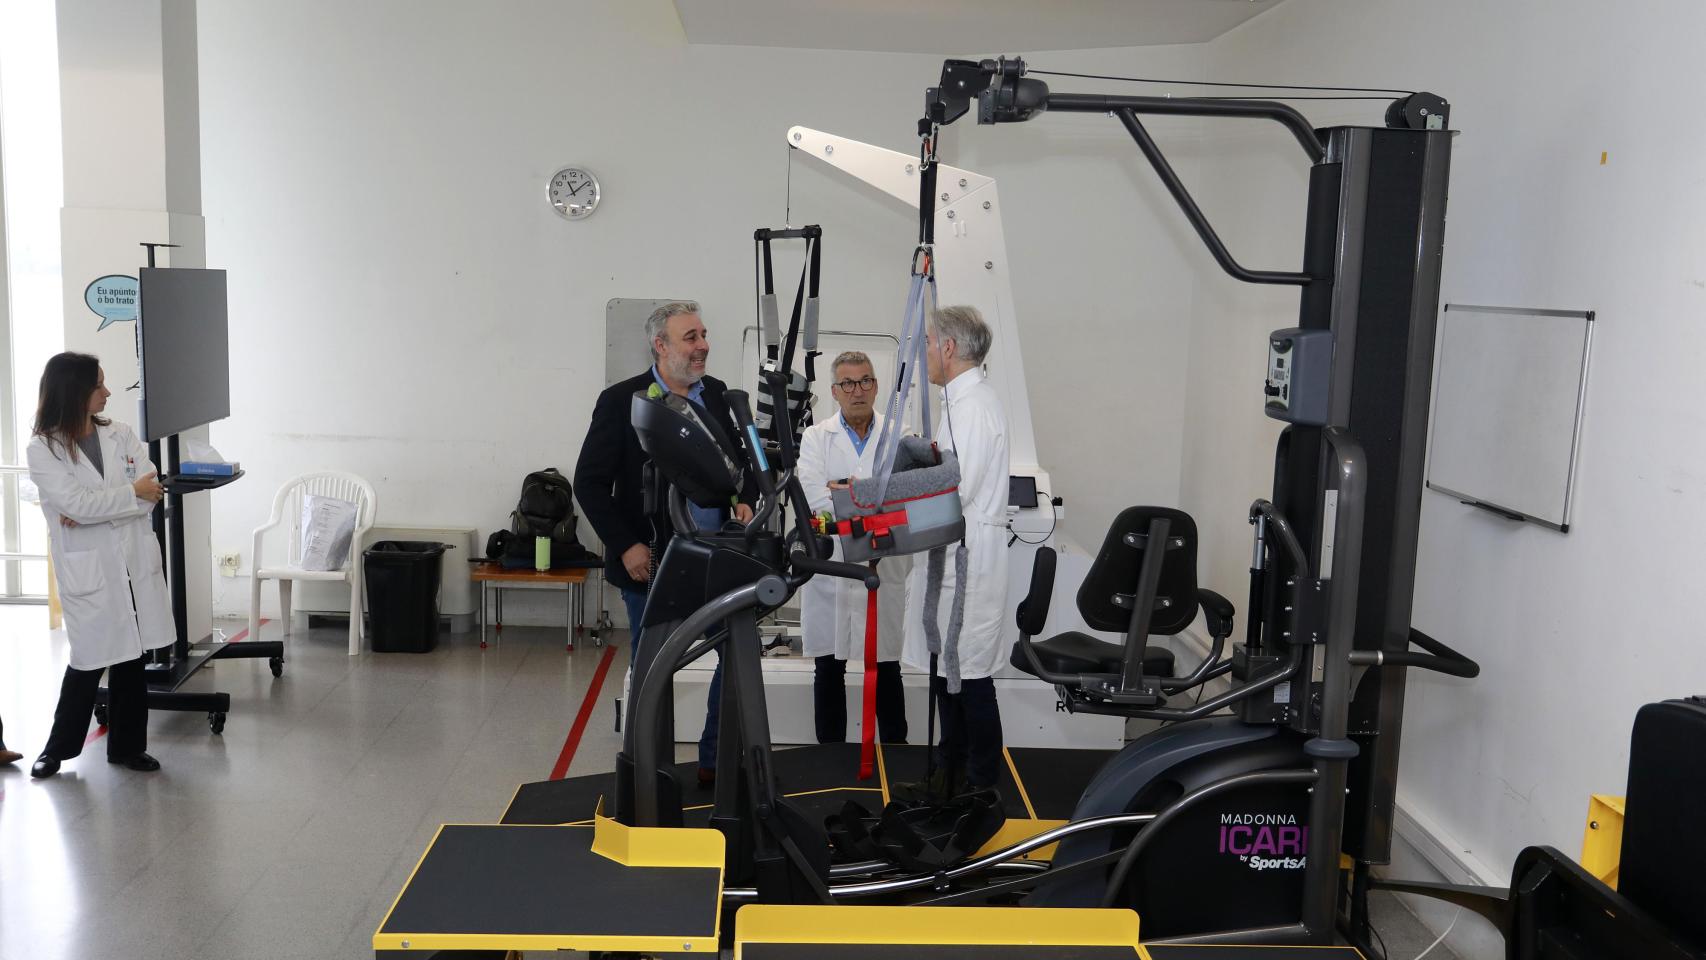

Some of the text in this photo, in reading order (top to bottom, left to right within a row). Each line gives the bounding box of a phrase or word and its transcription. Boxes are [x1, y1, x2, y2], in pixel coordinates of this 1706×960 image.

[97, 286, 107, 295] Eu
[104, 295, 115, 304] bo
[116, 296, 135, 305] trato
[1220, 813, 1297, 825] MADONNA
[1239, 854, 1307, 871] by SportsA
